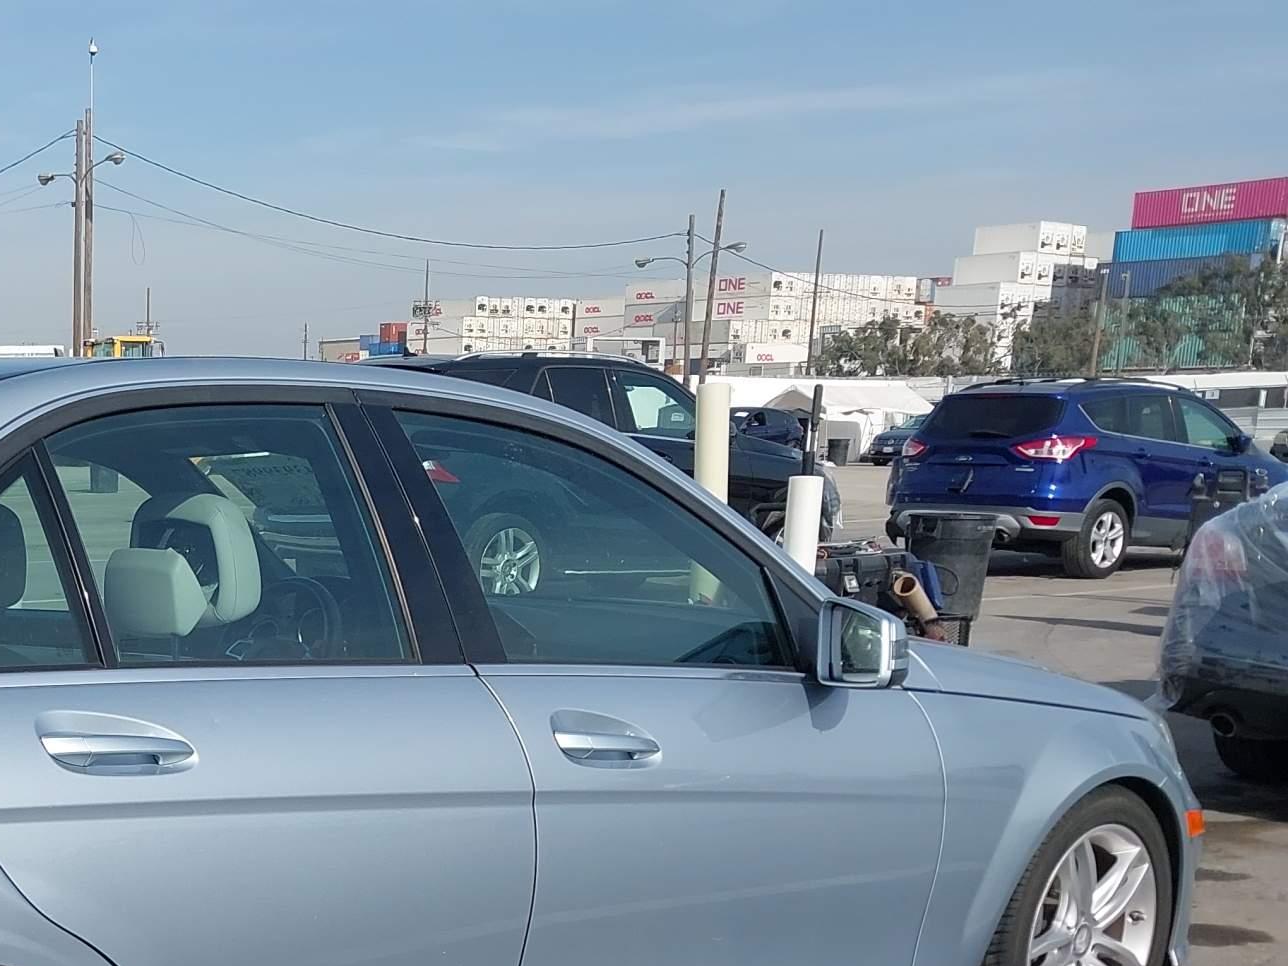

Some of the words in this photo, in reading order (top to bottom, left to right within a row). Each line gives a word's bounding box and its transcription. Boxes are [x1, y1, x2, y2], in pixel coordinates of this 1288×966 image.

[1181, 188, 1237, 213] ONE
[718, 277, 746, 292] ONE
[716, 301, 745, 315] ONE
